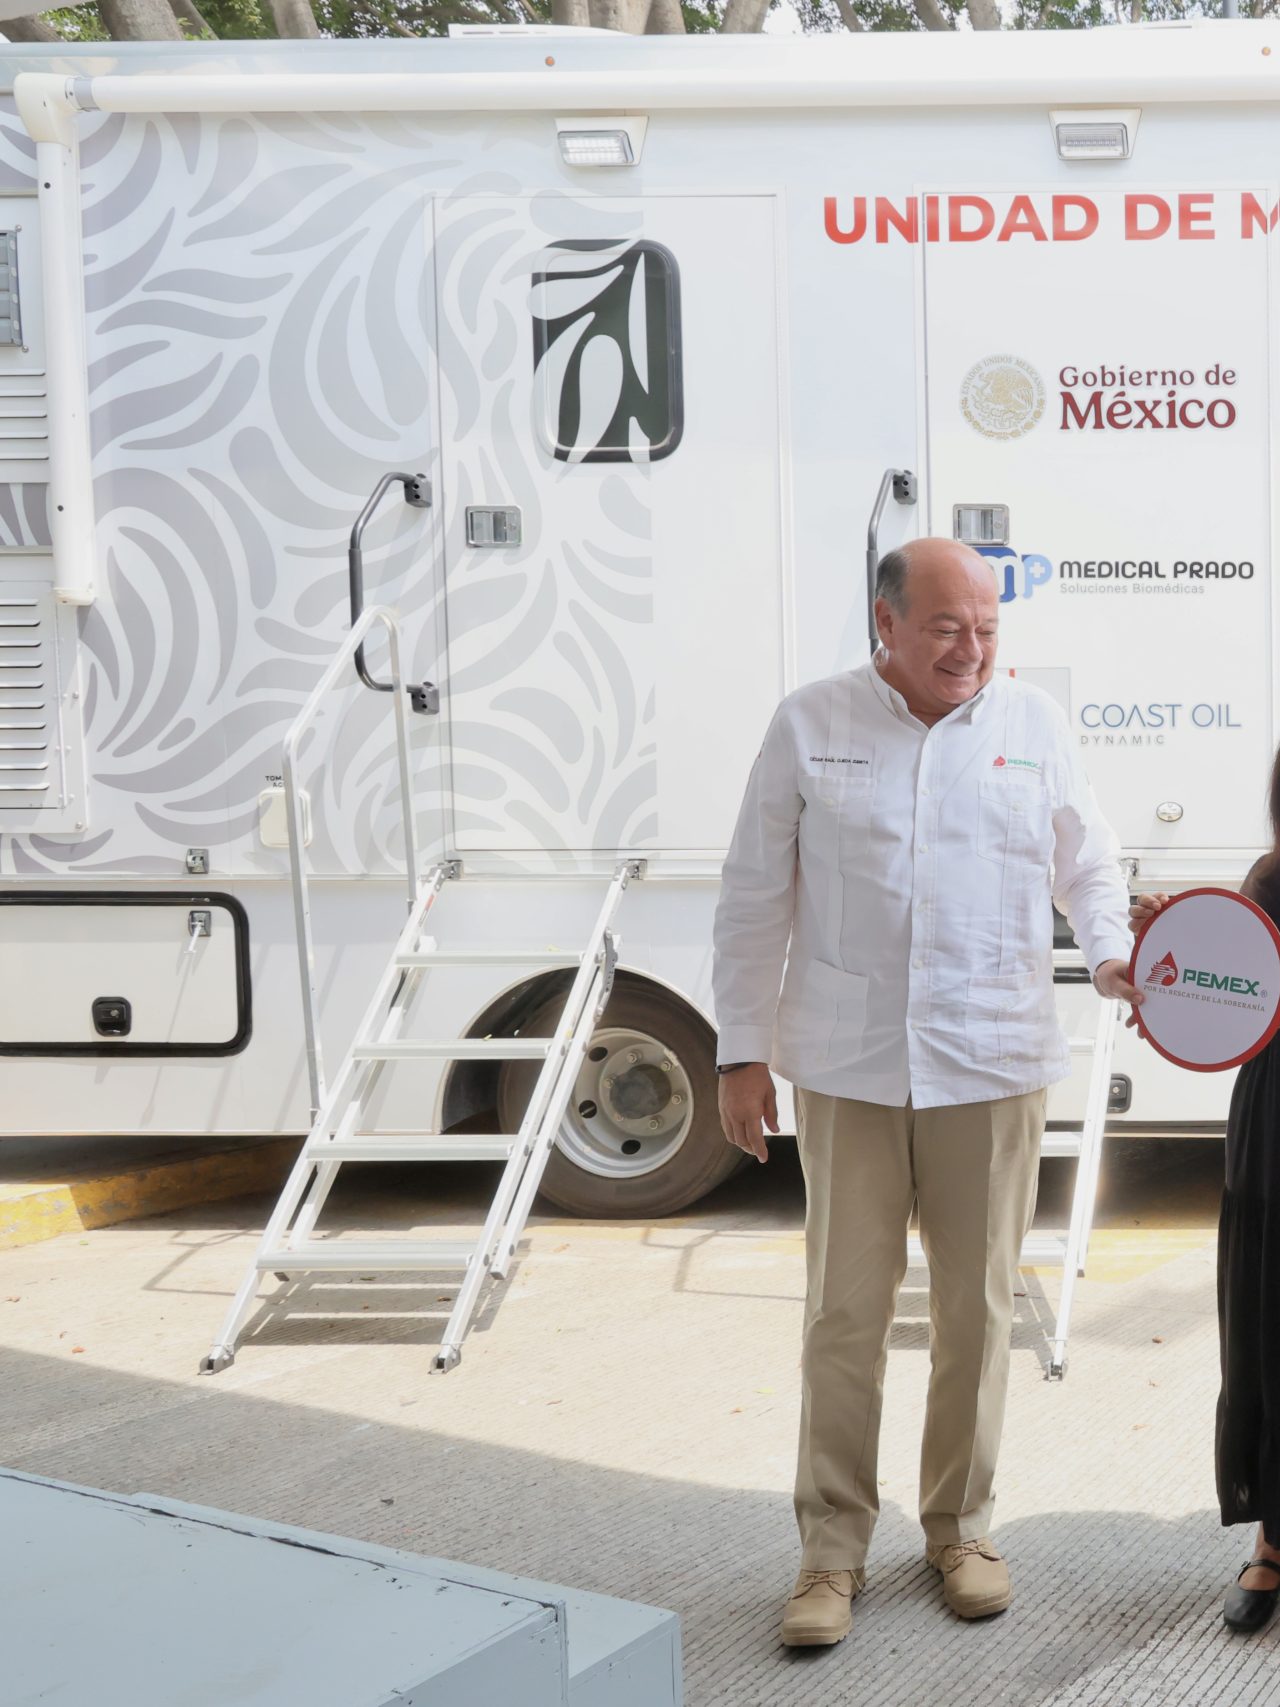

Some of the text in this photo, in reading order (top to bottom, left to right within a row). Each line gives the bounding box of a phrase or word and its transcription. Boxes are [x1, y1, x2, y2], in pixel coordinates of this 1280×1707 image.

[824, 194, 1099, 244] UNIDAD
[1124, 192, 1216, 241] DE
[1059, 363, 1237, 388] Gobierno de
[1060, 390, 1236, 430] México
[1060, 560, 1254, 579] MEDICAL PRADO
[1060, 582, 1205, 594] Soluciones Biomédicas
[1080, 704, 1241, 728] COAST OIL
[1080, 735, 1165, 745] DYNAMIC
[1182, 968, 1260, 996] PEMEX
[1143, 985, 1157, 993] POR
[1168, 989, 1200, 1000] RESCATE
[1223, 999, 1265, 1012] SOBERANÍA
